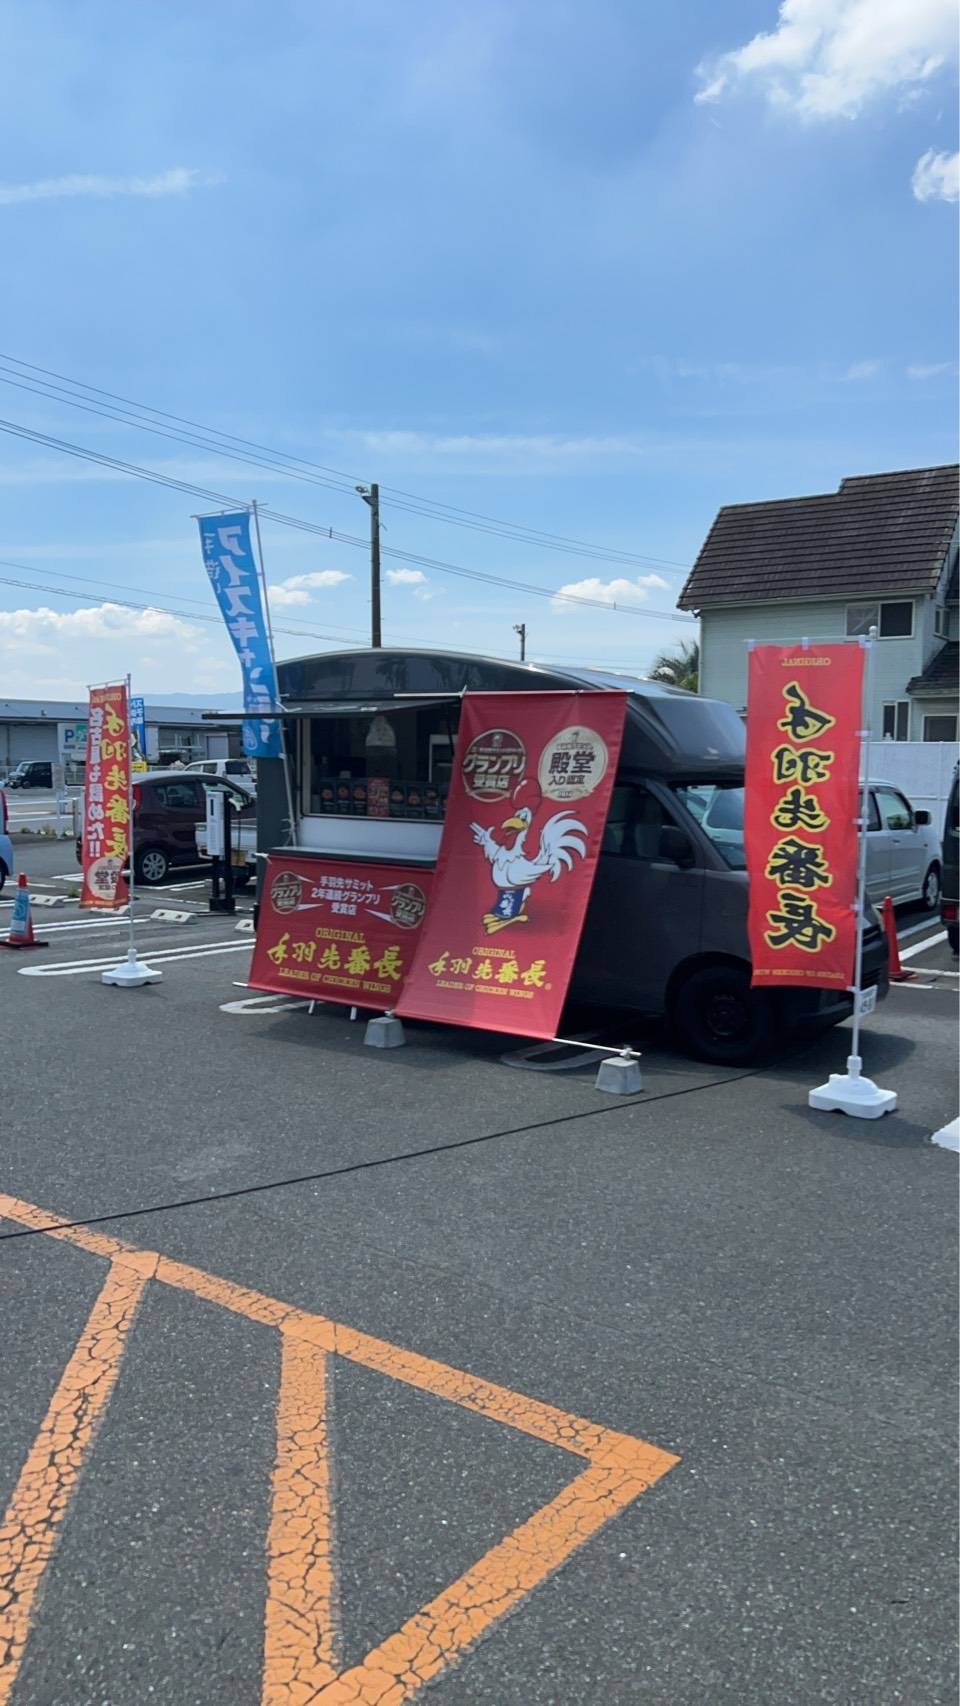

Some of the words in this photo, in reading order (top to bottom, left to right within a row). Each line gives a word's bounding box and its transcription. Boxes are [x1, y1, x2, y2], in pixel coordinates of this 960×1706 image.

[64, 729, 75, 743] P
[463, 753, 526, 774] グランプリ
[548, 751, 596, 774] 殿堂
[315, 927, 366, 943] ORIGINAL
[266, 932, 403, 980] 手羽先番長
[428, 951, 546, 987] 手羽先番長
